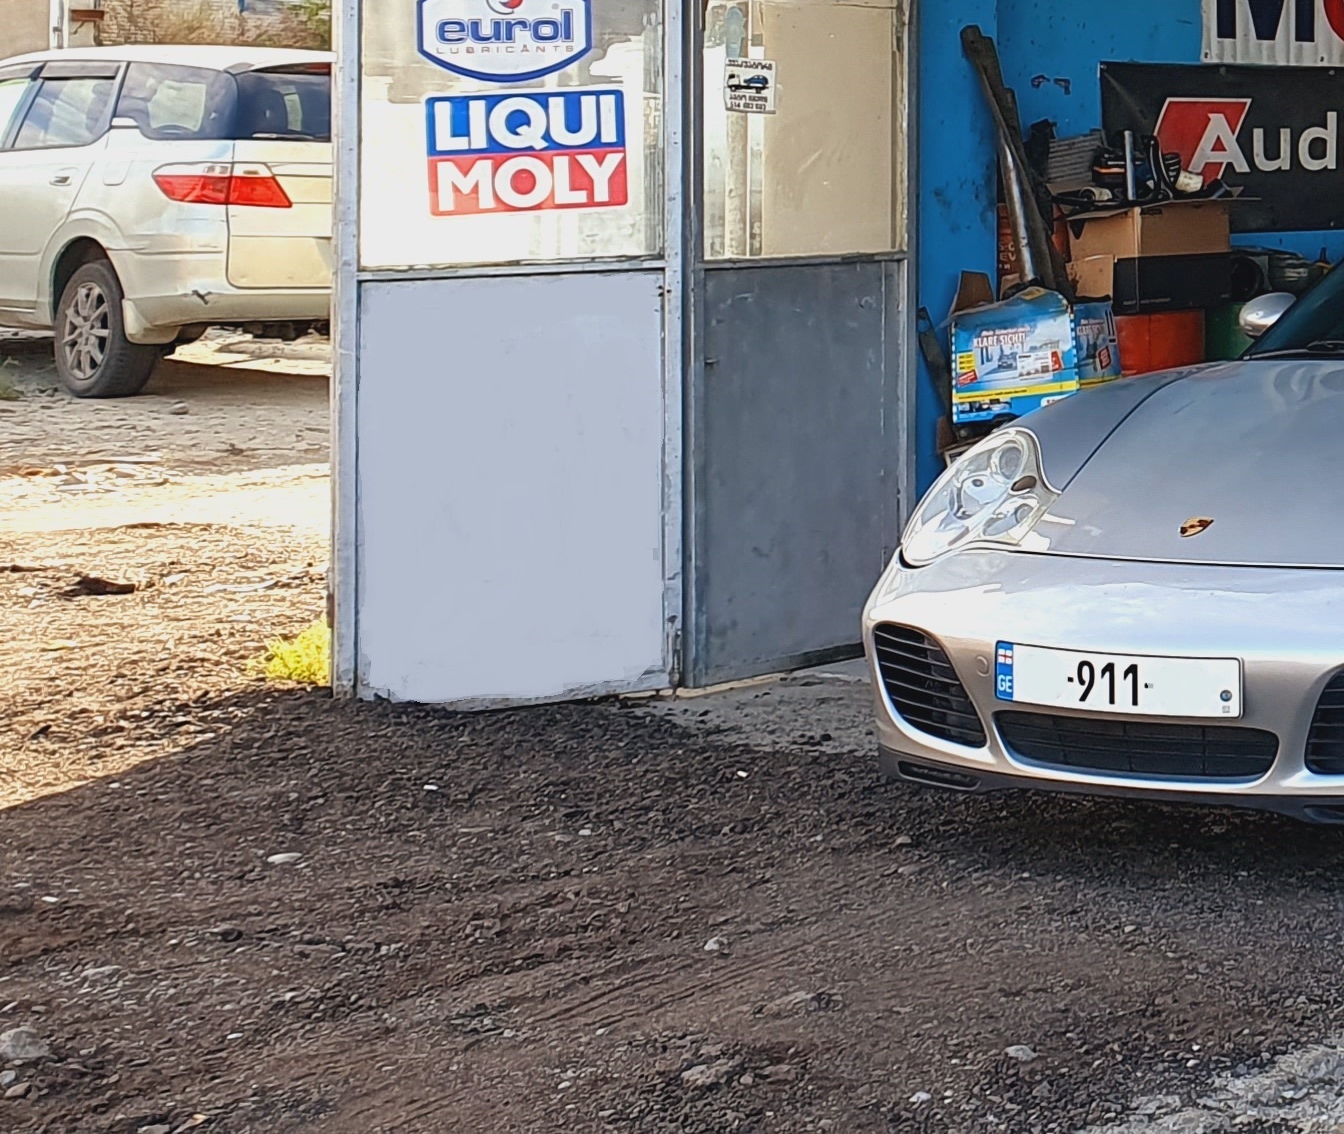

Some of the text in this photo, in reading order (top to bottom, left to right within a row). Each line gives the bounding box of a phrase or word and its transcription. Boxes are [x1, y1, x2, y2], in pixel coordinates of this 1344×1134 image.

[435, 8, 574, 45] eurol
[436, 43, 575, 55] LUBRICANTS
[433, 94, 618, 151] LIQUI
[436, 152, 625, 212] MOLY
[997, 674, 1013, 693] GE
